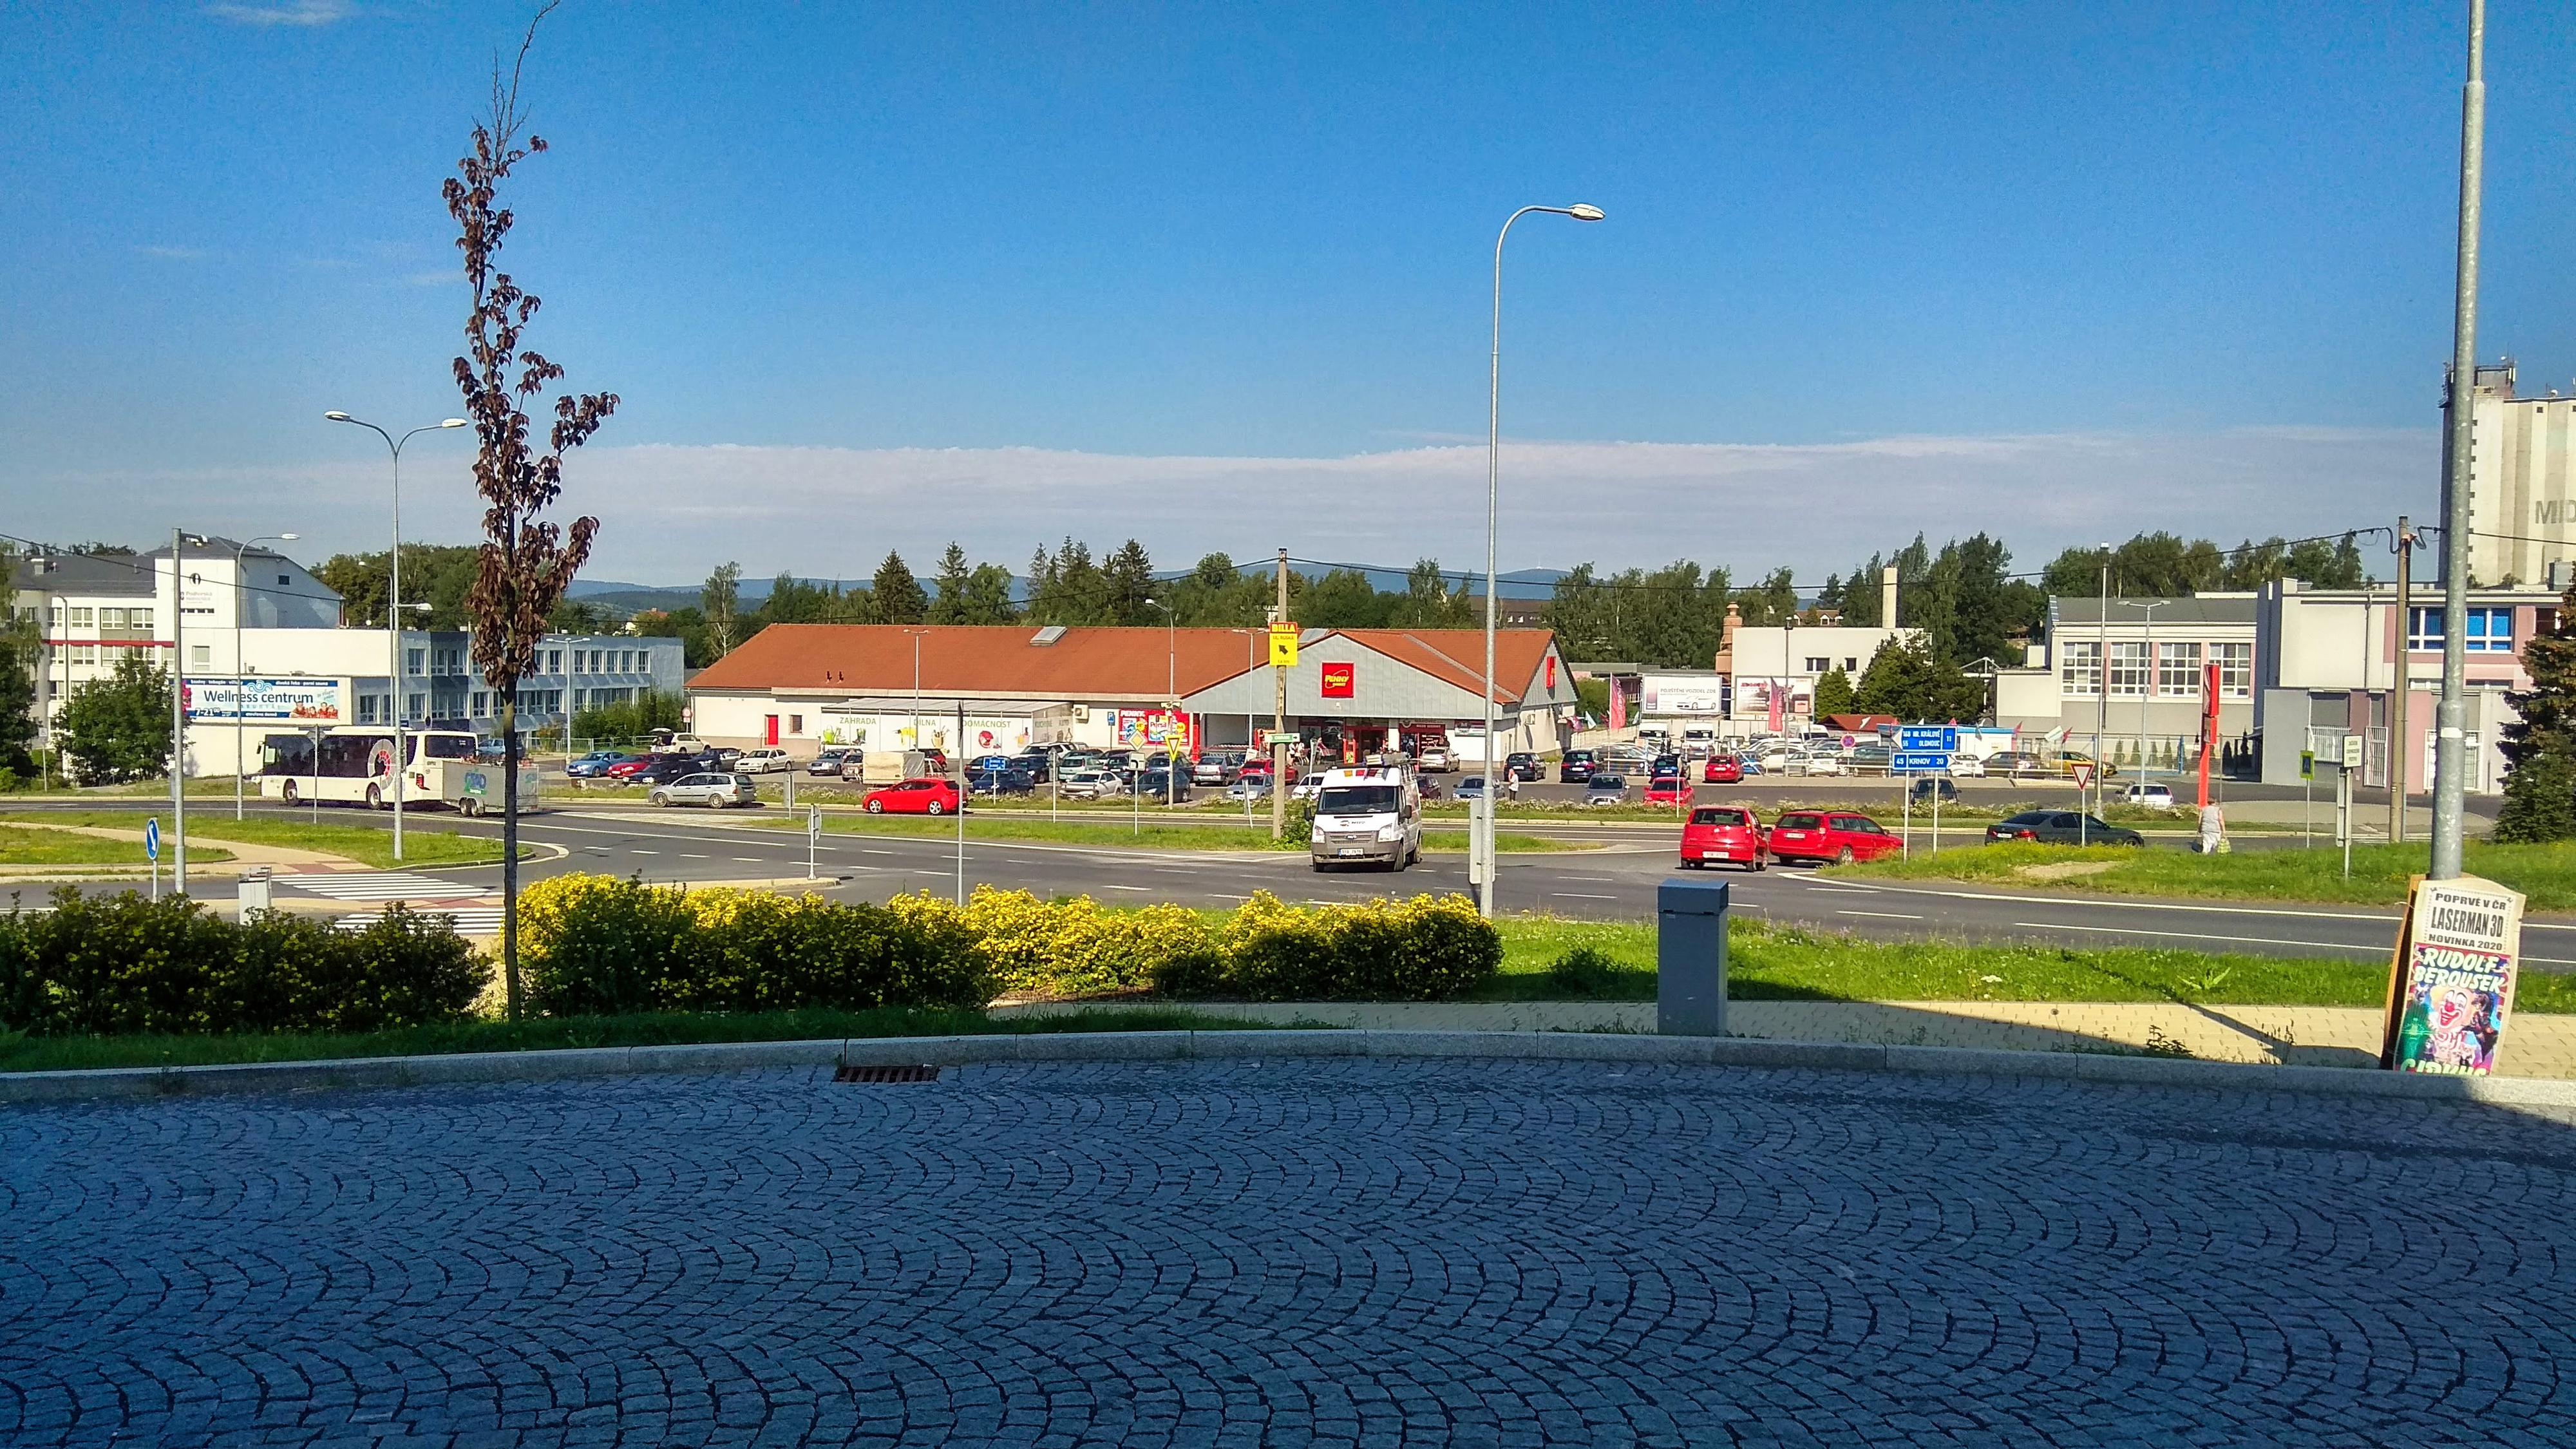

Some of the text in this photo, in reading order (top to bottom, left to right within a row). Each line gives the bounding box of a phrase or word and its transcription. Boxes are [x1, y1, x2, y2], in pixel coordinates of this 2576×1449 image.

[1271, 623, 1296, 632] BILLA
[1325, 674, 1350, 683] PENNY
[204, 690, 258, 703] Wellness
[261, 692, 314, 703] centrum
[2435, 893, 2481, 907] POPRVÉ
[2492, 900, 2507, 911] ČR
[2430, 907, 2505, 938] LASERMAN 3D
[2429, 934, 2503, 951] NOVINKA 2020
[2423, 947, 2500, 974] RUDOLF
[2413, 965, 2506, 995] BEROUSEK
